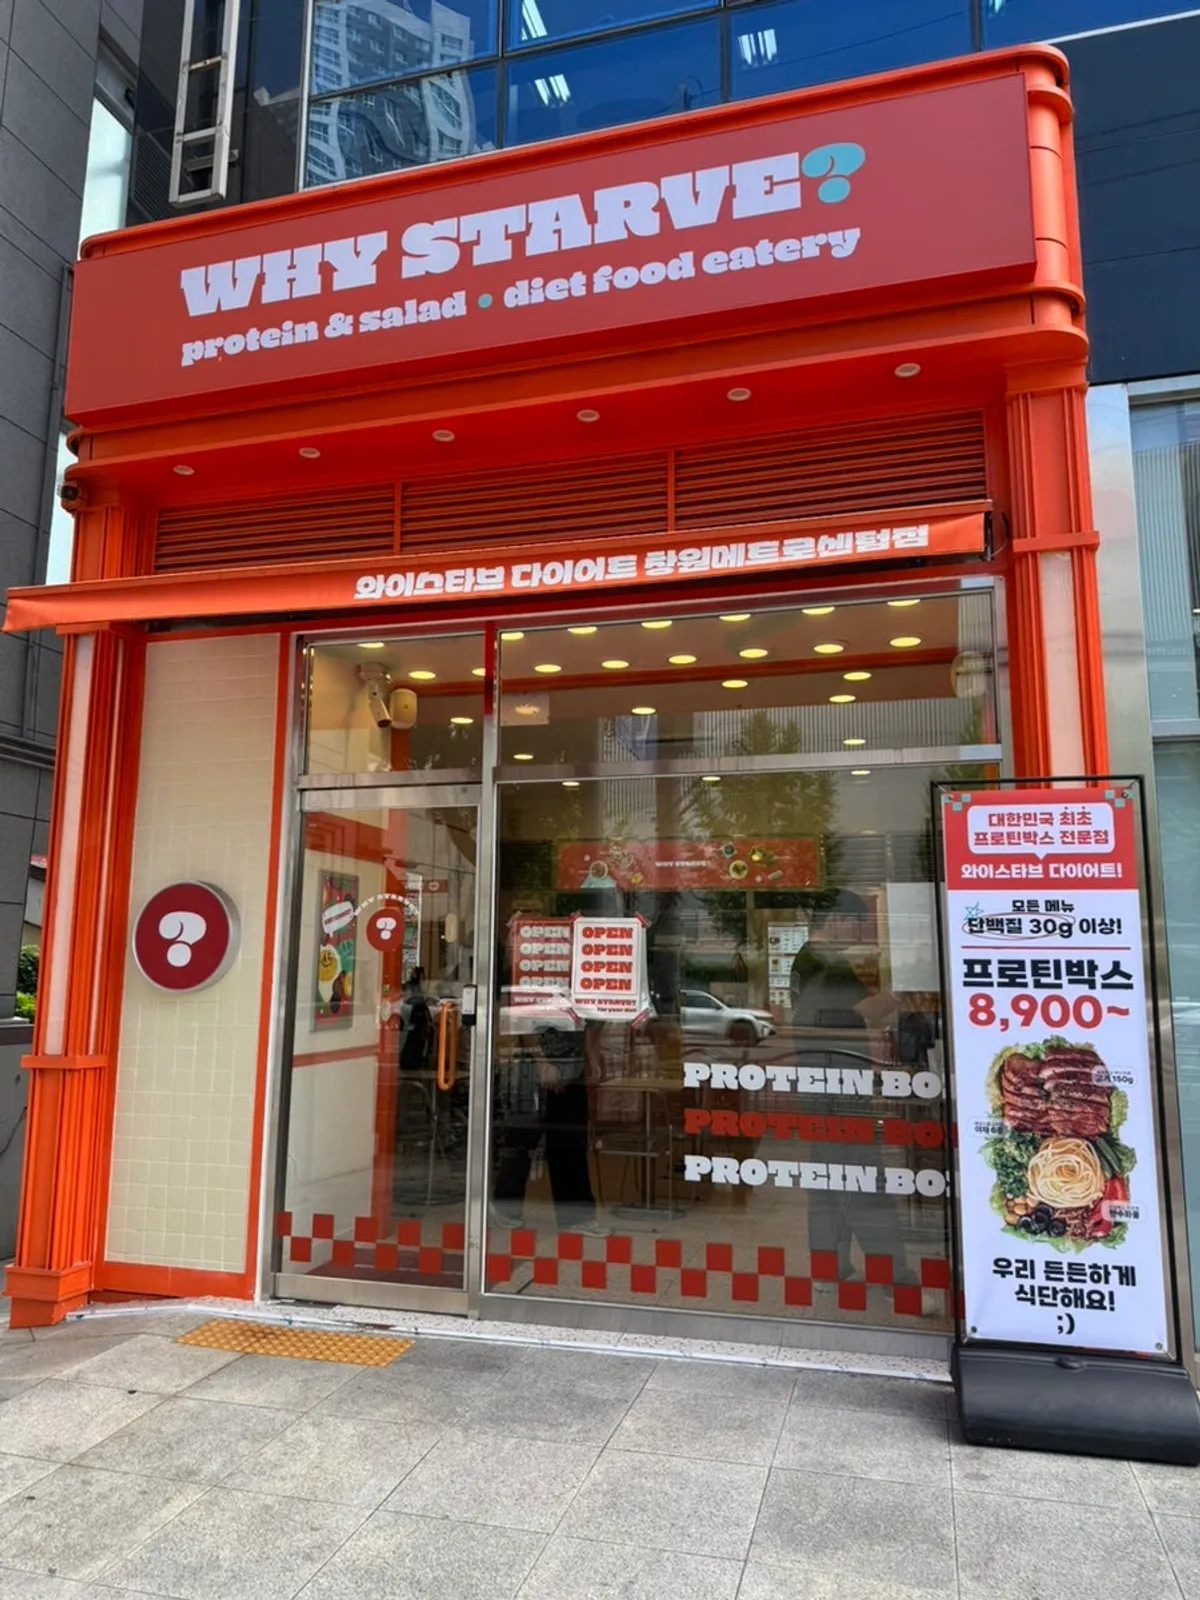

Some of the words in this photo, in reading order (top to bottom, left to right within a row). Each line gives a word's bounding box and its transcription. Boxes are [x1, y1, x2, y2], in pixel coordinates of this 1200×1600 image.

[180, 230, 388, 317] WHY
[401, 142, 866, 279] STARVE?
[181, 320, 319, 367] protein
[324, 312, 353, 338] &
[358, 290, 467, 332] salad
[503, 270, 587, 309] diet
[592, 251, 696, 294] food
[701, 227, 861, 273] eatery
[353, 565, 505, 599] 와이스타브
[511, 554, 637, 588] 다이어트
[987, 812, 1054, 827] 대한민국
[1059, 806, 1093, 826] 최초
[973, 830, 1054, 846] 프로틴박스
[1059, 829, 1110, 845] 전문점
[960, 863, 1045, 879] 와이스타브
[1048, 862, 1122, 878] 다이어트!
[1011, 899, 1040, 913] 모든
[1044, 899, 1075, 913] 메뉴
[520, 926, 570, 938] OPEN
[582, 926, 633, 939] OPEN
[967, 917, 1023, 935] 단백질
[1029, 919, 1073, 939] 30g
[1078, 918, 1123, 935] 이상!
[520, 943, 570, 955] OPEN
[581, 944, 633, 956] OPEN
[581, 961, 633, 973] OPEN
[963, 959, 1134, 990] 프로틴박스
[580, 977, 632, 990] OPEN
[969, 993, 1130, 1032] 8,900~
[683, 1062, 874, 1097] PROTEIN
[882, 1070, 946, 1099] BO
[684, 1108, 874, 1144] PROTEIN
[684, 1155, 877, 1193] PROTEIN
[884, 1167, 951, 1198] BO
[992, 1257, 1036, 1280] 우리
[1043, 1260, 1137, 1287] 든든하게
[1014, 1283, 1116, 1312] 식단해요!
